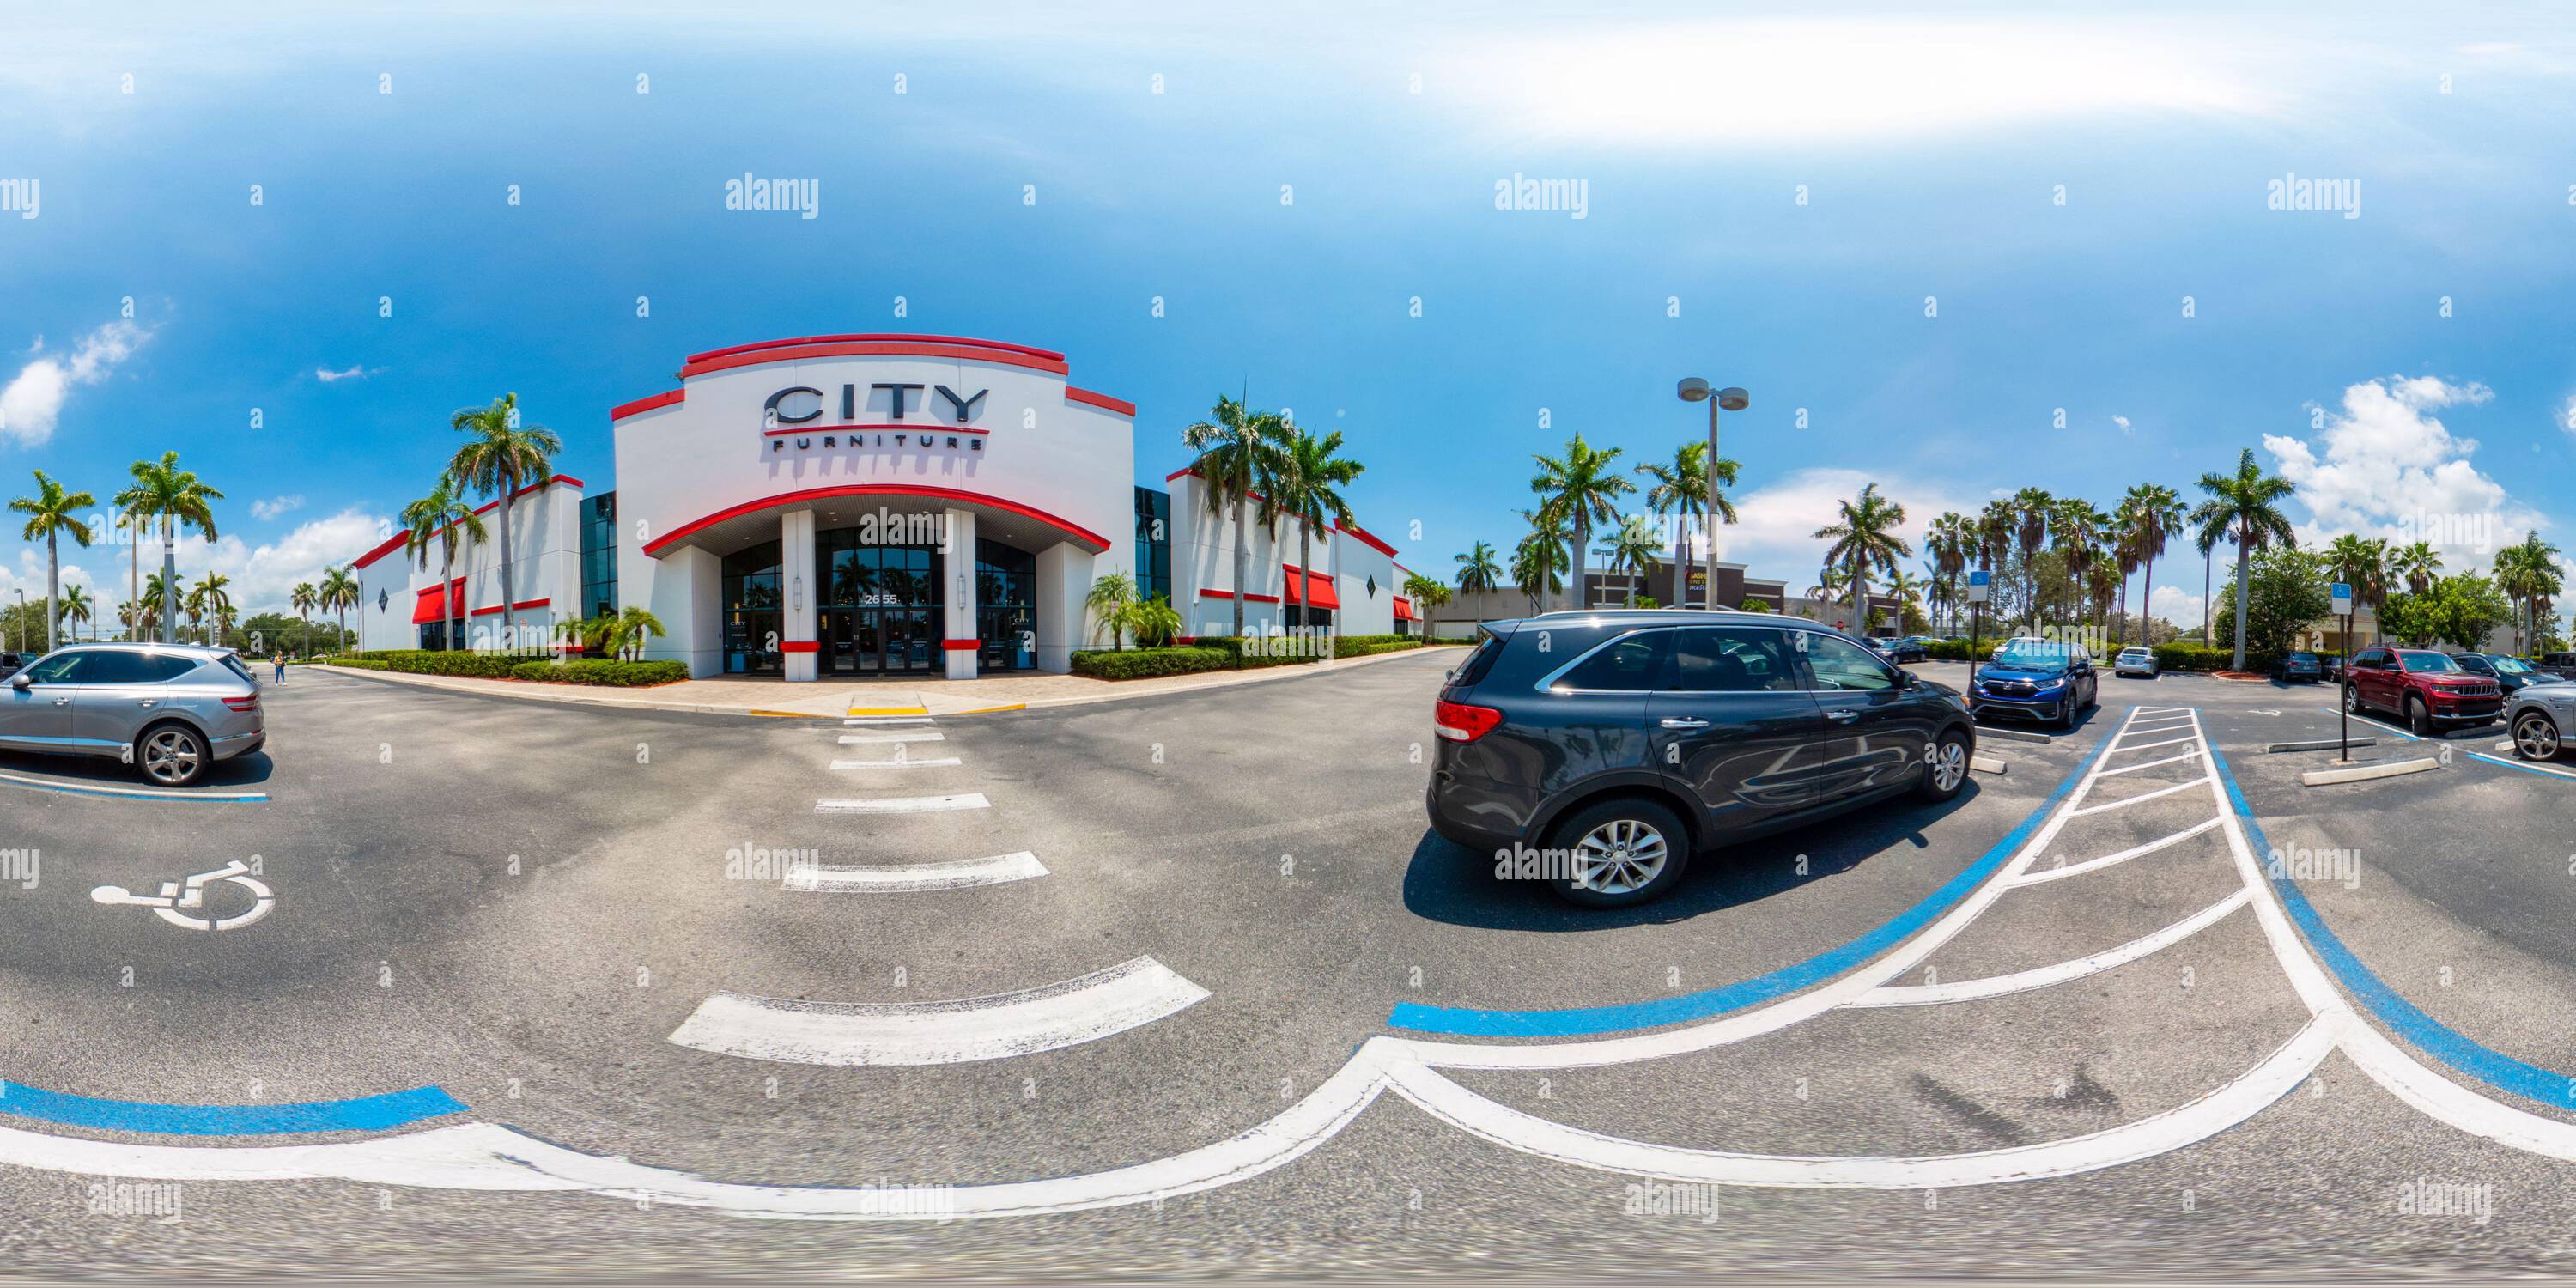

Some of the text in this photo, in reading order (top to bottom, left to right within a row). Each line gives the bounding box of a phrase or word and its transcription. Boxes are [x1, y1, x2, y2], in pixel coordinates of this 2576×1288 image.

[763, 383, 989, 423] CITY
[773, 434, 982, 453] FURNITURE
[865, 594, 897, 605] 2655
